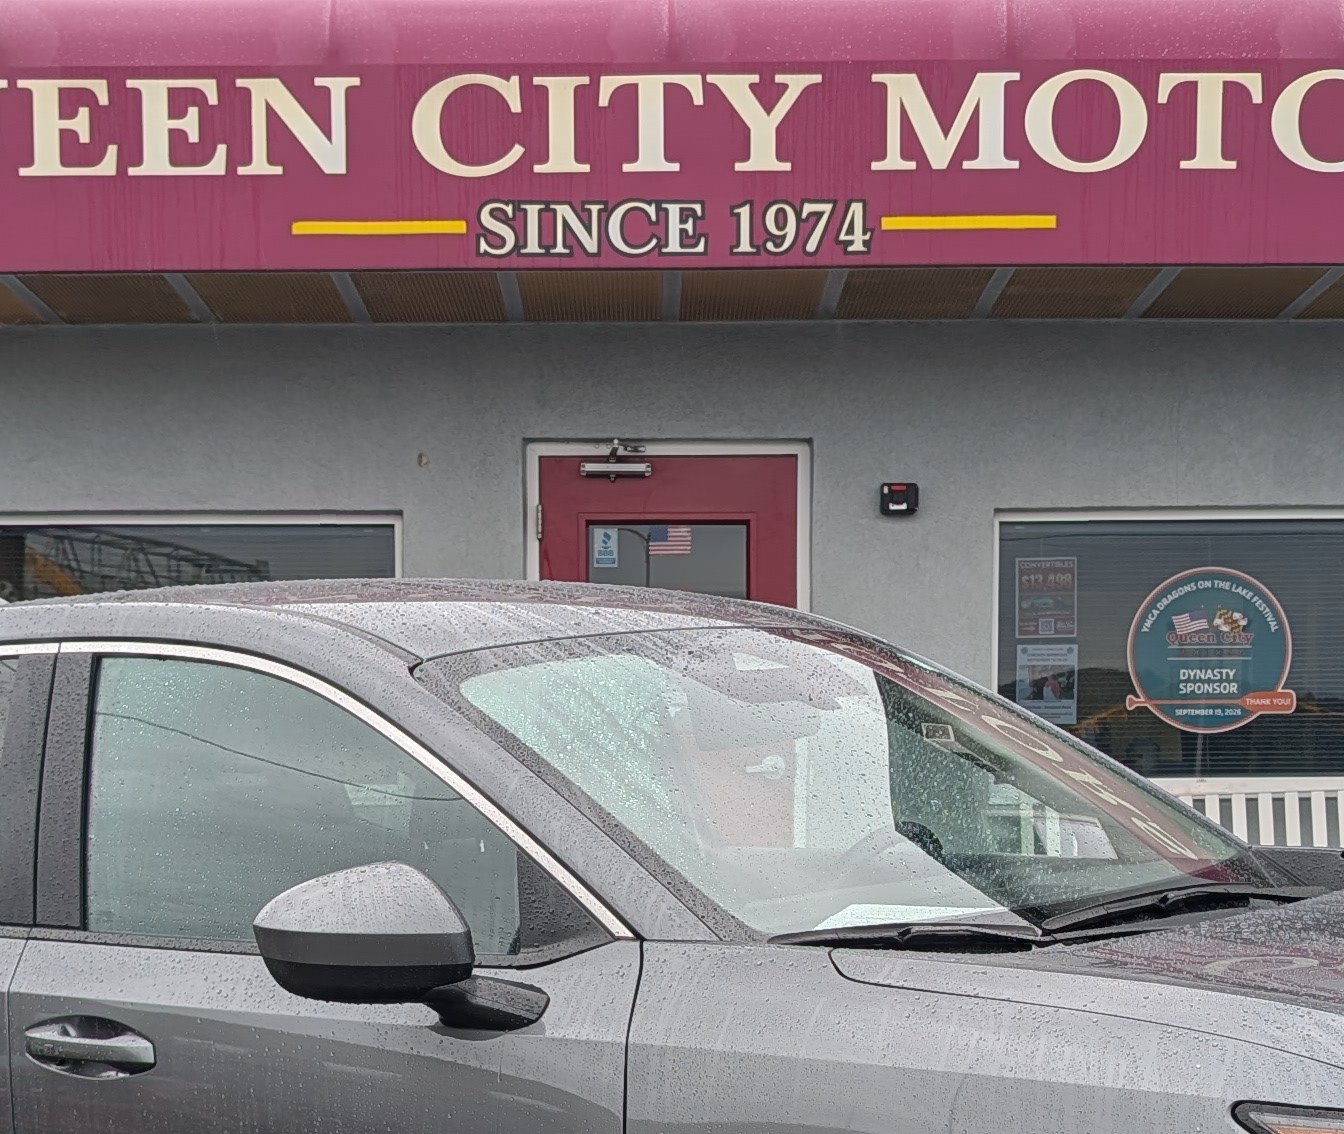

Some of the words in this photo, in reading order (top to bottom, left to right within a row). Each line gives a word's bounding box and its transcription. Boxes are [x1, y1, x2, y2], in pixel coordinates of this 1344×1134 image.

[411, 70, 823, 178] CITY
[474, 197, 708, 257] SINCE
[729, 196, 874, 255] 1974
[1141, 609, 1160, 633] YMCA
[1156, 581, 1197, 612] DRAGONS
[1197, 579, 1212, 589] ON
[1213, 579, 1231, 591] THE
[1231, 583, 1255, 601] LAKE
[1250, 595, 1280, 633] FESTIVAL
[1166, 630, 1217, 646] Queen
[1219, 631, 1255, 646] City
[1179, 668, 1237, 680] DYNASTY
[1178, 682, 1239, 695] SPONSOR
[1245, 697, 1272, 706] THANK
[1272, 697, 1292, 706] YOU!
[1174, 708, 1214, 716] SEPTEMBER
